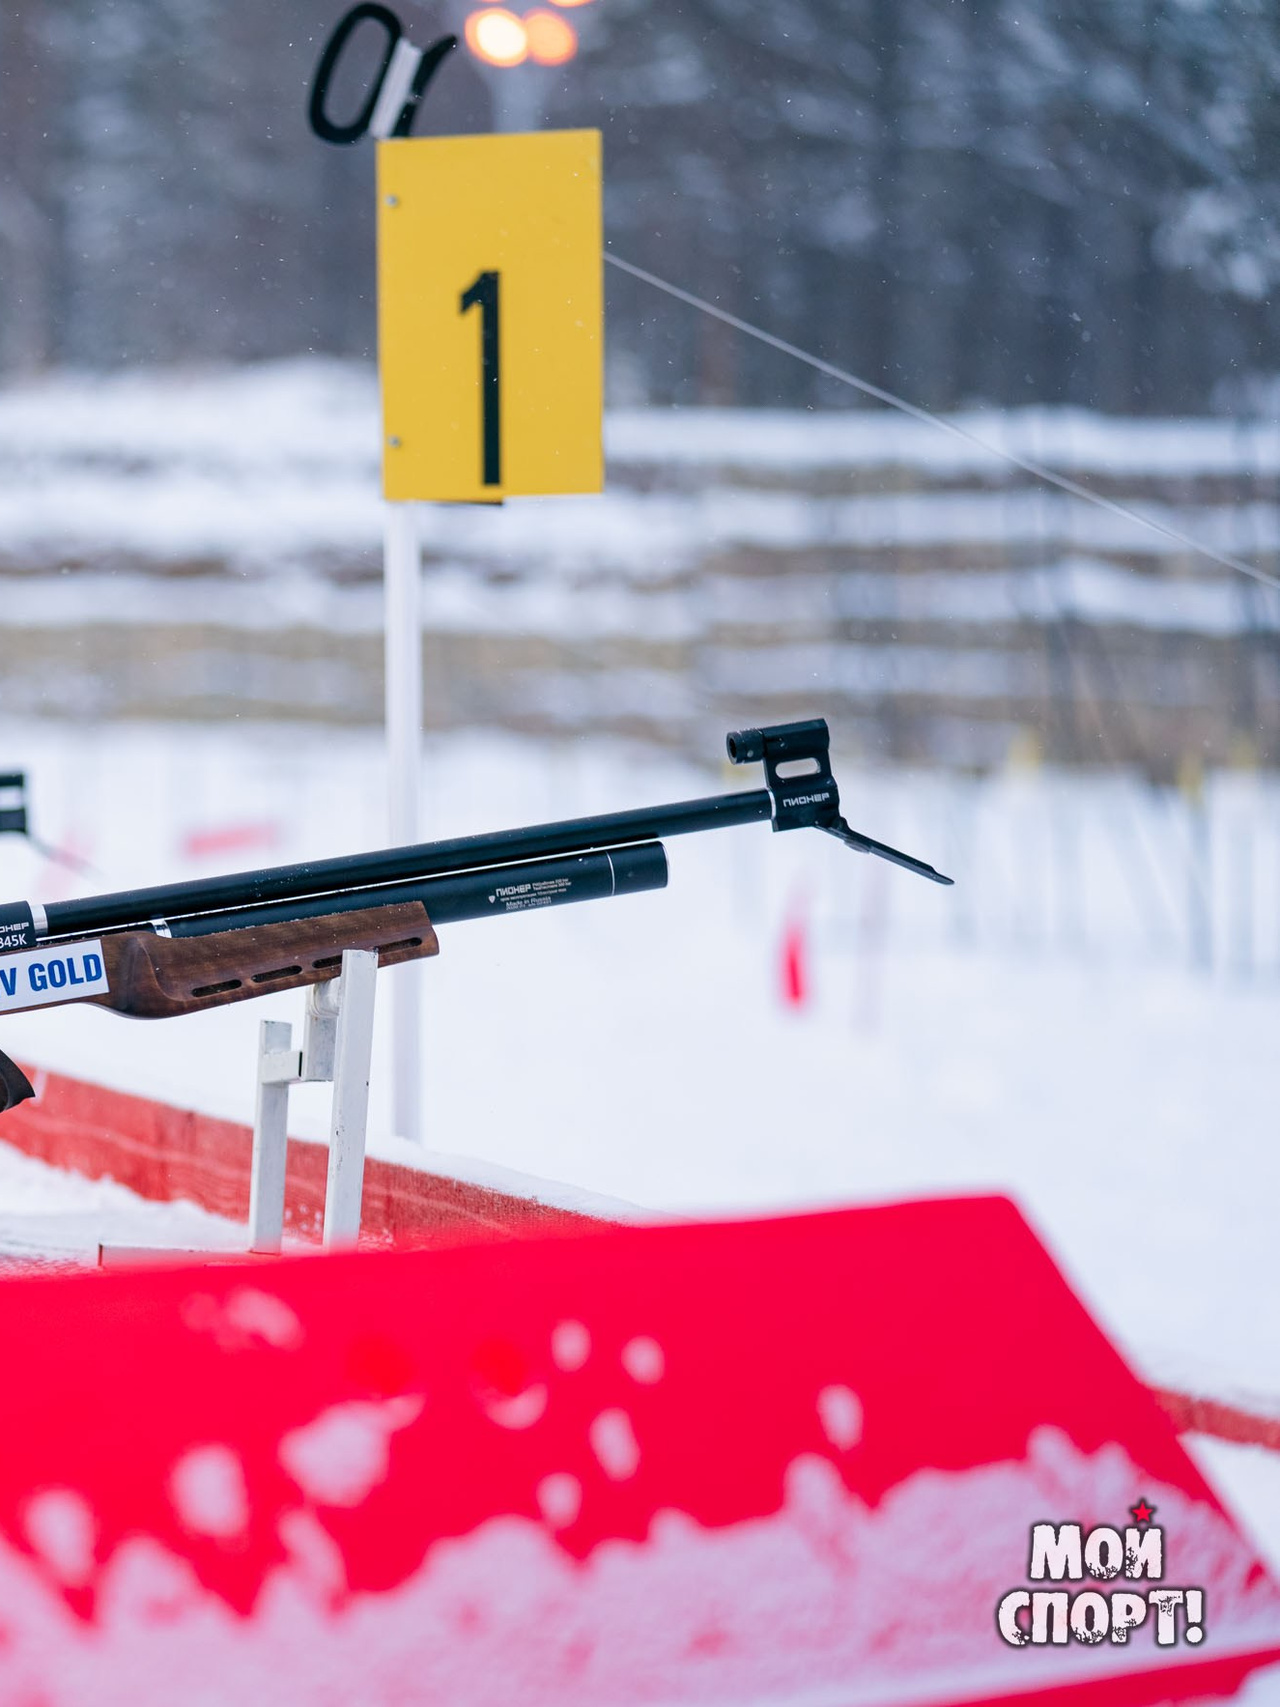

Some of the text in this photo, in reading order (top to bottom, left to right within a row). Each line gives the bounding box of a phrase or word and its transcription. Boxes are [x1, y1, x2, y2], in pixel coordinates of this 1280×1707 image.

[459, 270, 502, 486] 1
[783, 792, 830, 807] ПИОНЕР
[496, 884, 531, 897] ПИОНЕР
[28, 953, 103, 992] GOLD
